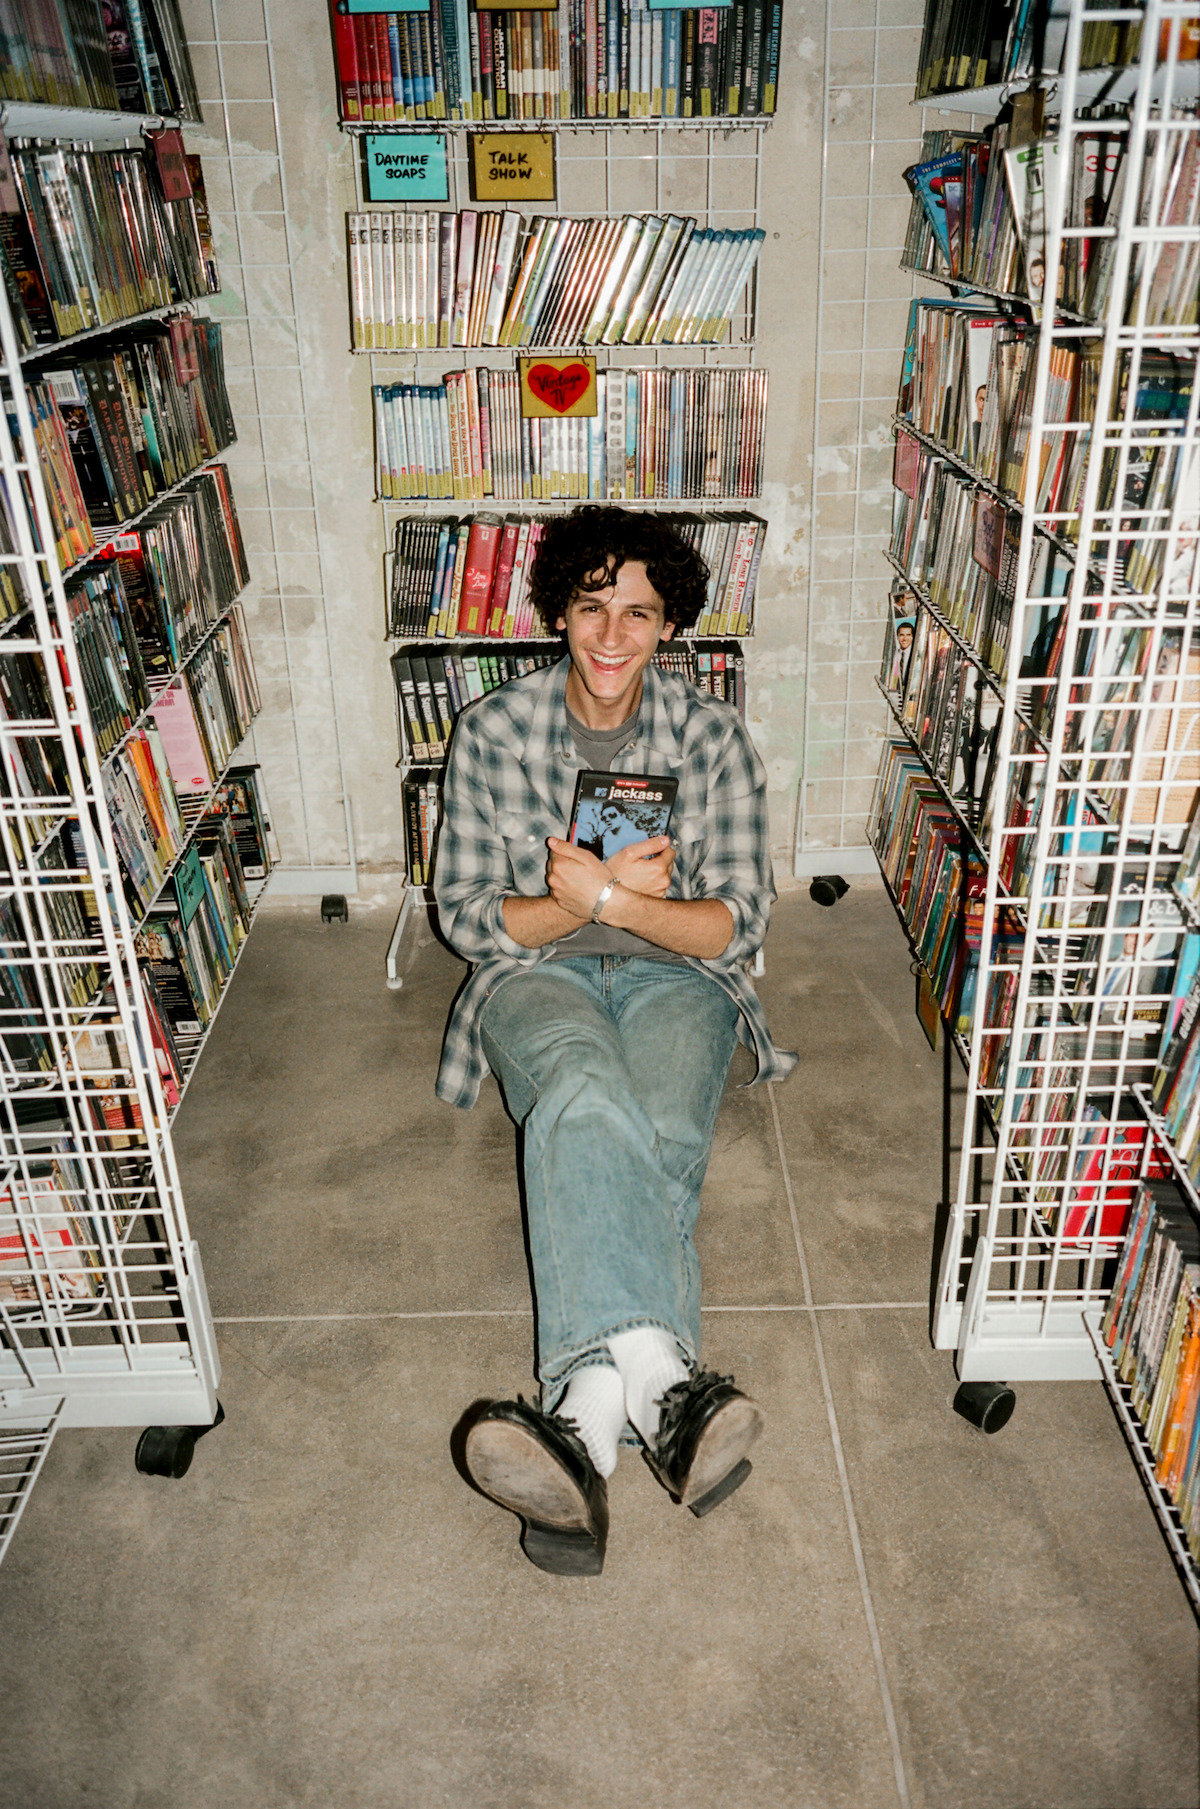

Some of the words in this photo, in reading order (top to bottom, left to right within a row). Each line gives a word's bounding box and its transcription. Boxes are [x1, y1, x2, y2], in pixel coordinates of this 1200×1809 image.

[470, 12, 478, 33] DINNER
[736, 5, 744, 27] ALFRED
[754, 8, 762, 30] ALFRED
[735, 29, 743, 64] HITCHCOCK
[752, 33, 760, 68] HITCHCOCK
[770, 29, 779, 65] HITCHCOCK
[769, 67, 777, 84] PRESE
[750, 70, 759, 100] PRESENTS
[375, 153, 429, 166] DAYTIME
[488, 151, 528, 165] TALK
[933, 158, 957, 169] COMPLETE
[385, 167, 426, 180] SOAPS
[489, 167, 533, 180] SHOW
[550, 388, 568, 404] TV
[98, 399, 114, 431] DARK
[109, 435, 131, 491] SHADOWS
[112, 401, 125, 433] DARK
[121, 436, 139, 491] SHADOWS
[736, 539, 744, 553] LONE
[467, 568, 475, 576] I
[731, 554, 741, 574] RANGER
[739, 559, 750, 579] LONE
[472, 580, 489, 589] Lucy
[473, 572, 486, 580] Love
[733, 581, 746, 612] RANGER
[401, 681, 414, 693] M
[417, 682, 431, 695] M
[434, 682, 447, 695] M
[714, 676, 722, 696] PETER
[405, 696, 418, 722] Squad
[421, 697, 434, 723] Squad
[608, 786, 663, 801] jackass
